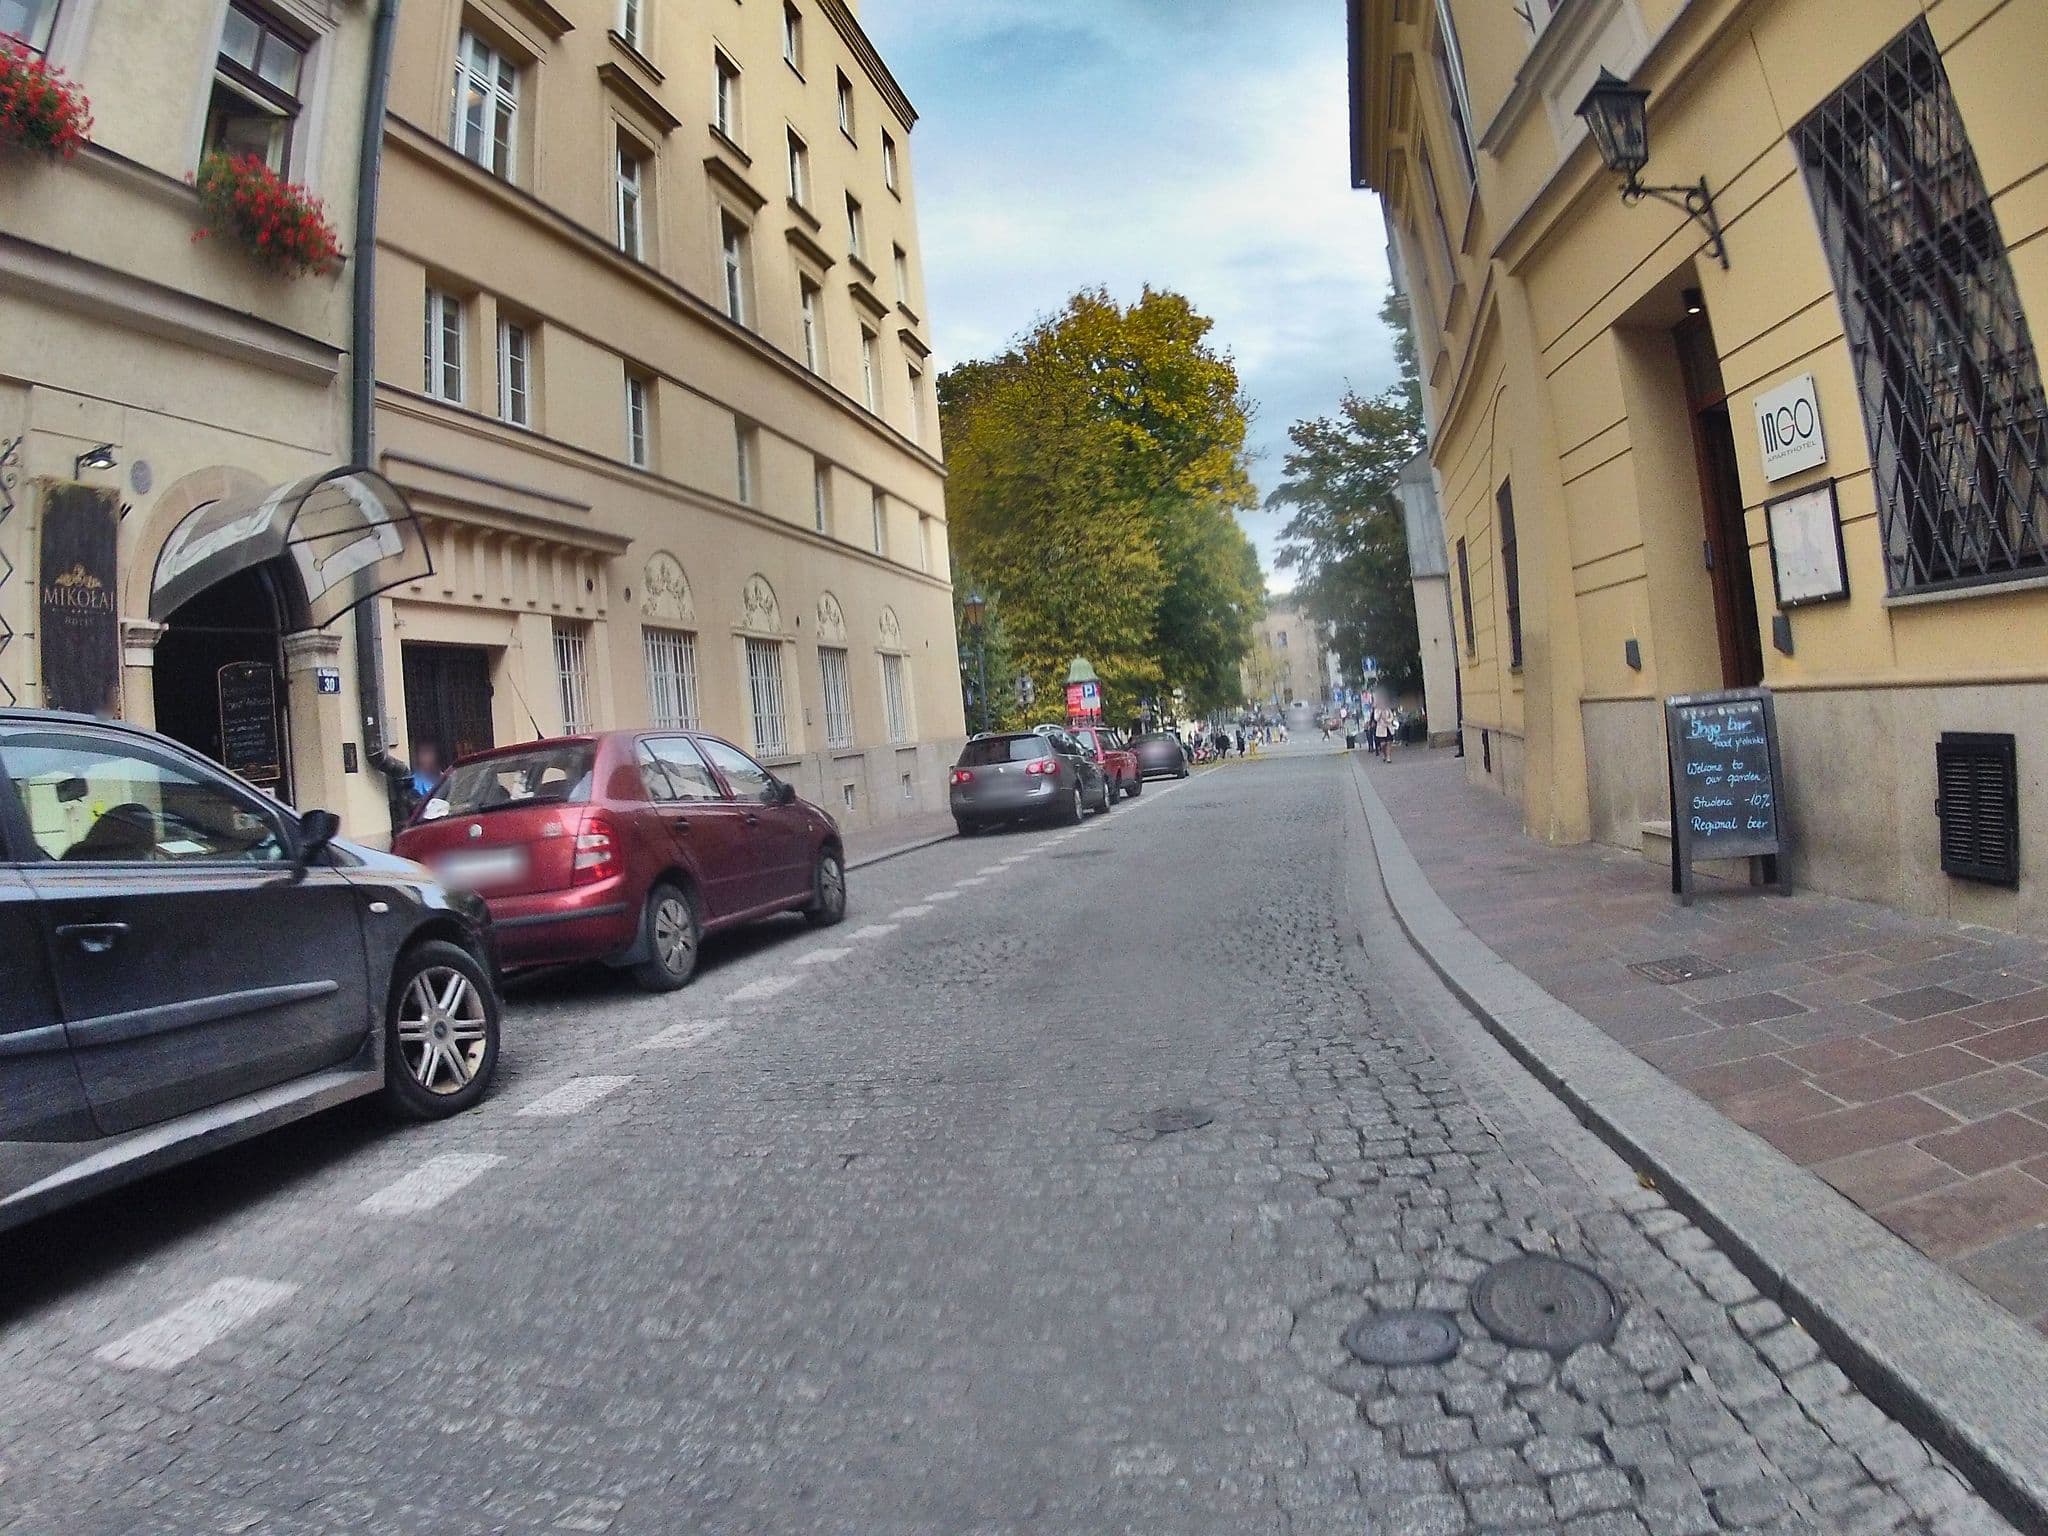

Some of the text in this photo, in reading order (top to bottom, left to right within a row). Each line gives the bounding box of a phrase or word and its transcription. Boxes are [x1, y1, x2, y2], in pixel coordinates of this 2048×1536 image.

[1761, 398, 1814, 454] INGO
[44, 586, 115, 613] MIKOŁAJ
[324, 677, 335, 692] 30
[1084, 684, 1094, 698] P
[1727, 715, 1752, 731] bar
[1686, 759, 1744, 776] Welcome to
[1705, 771, 1761, 788] our garden
[1744, 793, 1770, 809] -10%
[1691, 816, 1768, 836] Regional beer
